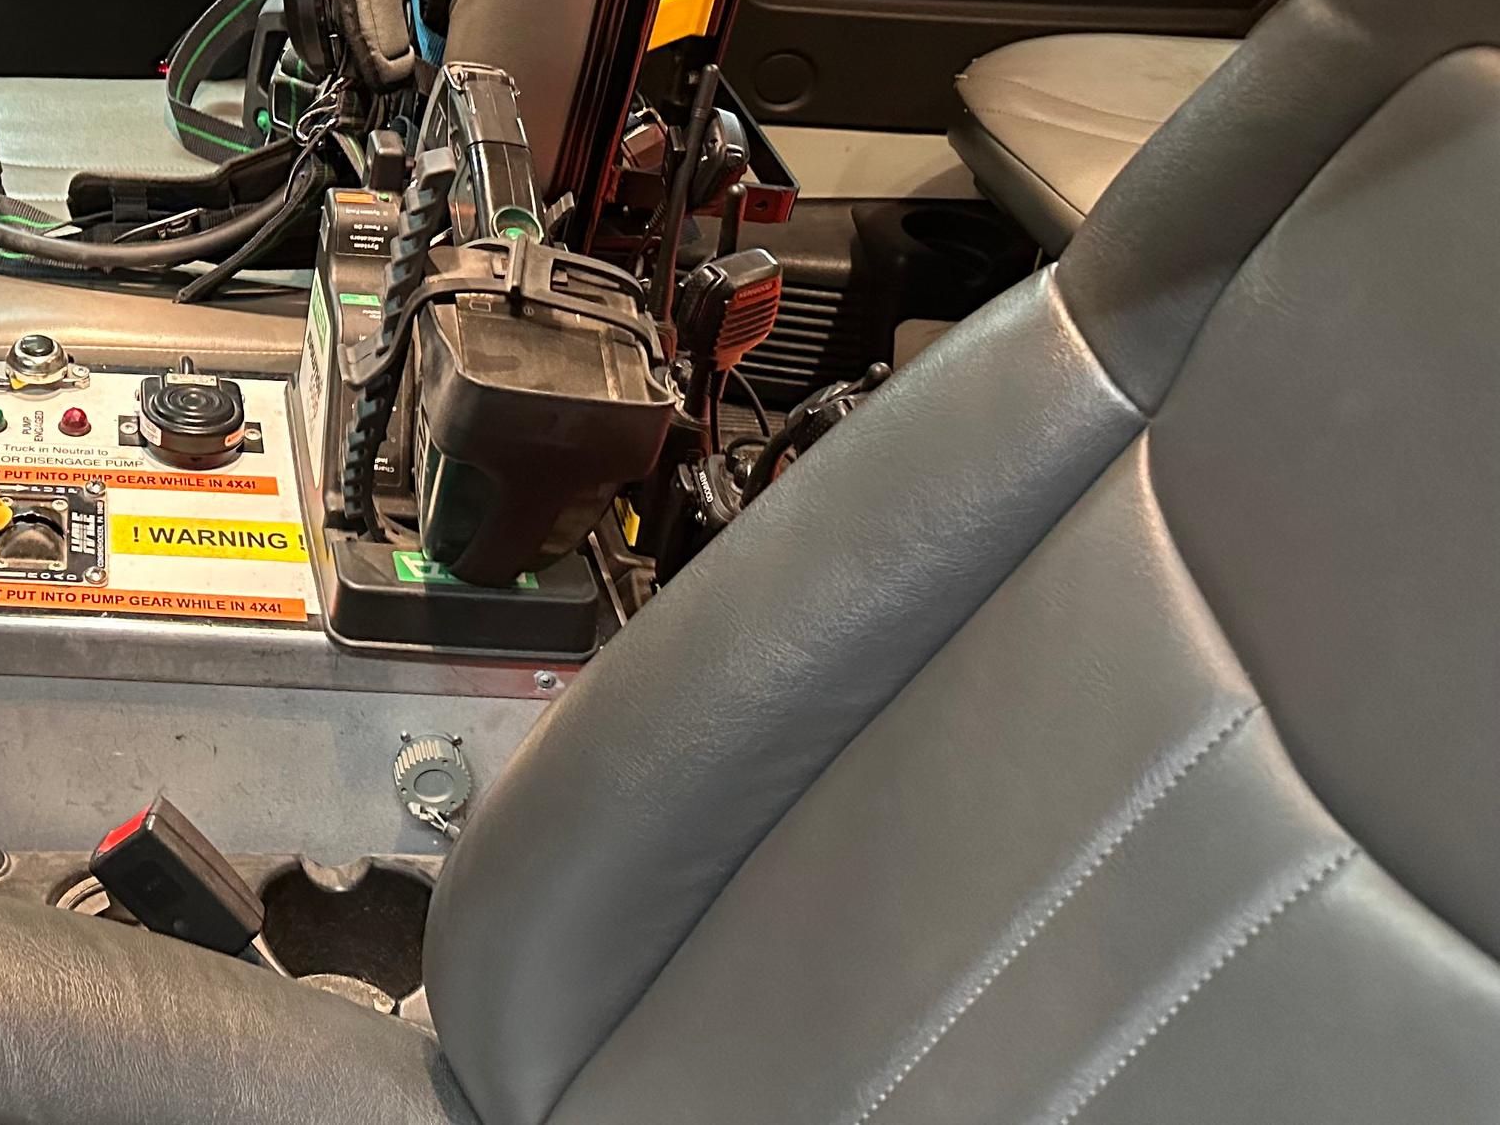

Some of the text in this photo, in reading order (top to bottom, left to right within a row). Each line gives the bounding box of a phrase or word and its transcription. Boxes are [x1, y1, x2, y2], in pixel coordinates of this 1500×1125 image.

[350, 235, 385, 244] Indicators
[354, 243, 379, 251] System
[22, 416, 32, 435] PUMP
[34, 410, 44, 442] ENGAGED
[4, 443, 35, 453] Truck
[38, 445, 49, 453] in
[52, 445, 94, 456] Neutral
[97, 447, 109, 456] to
[1, 455, 20, 464] OR
[24, 456, 102, 466] DISENGAGE
[105, 459, 144, 468] PUMP
[4, 470, 30, 480] PUT
[36, 471, 68, 482] INTO
[73, 473, 113, 483] PUMP
[116, 474, 156, 485] GEAR
[159, 476, 206, 487] WHILE
[209, 477, 223, 487] IN
[226, 478, 257, 489] 4X4!
[699, 471, 714, 504] KENWOOD
[31, 485, 78, 494] PUMP
[132, 526, 139, 543] !
[149, 527, 288, 550] WARNING
[27, 572, 77, 581] ROAD
[6, 589, 35, 601] PUT
[40, 590, 77, 603] INTO
[81, 592, 124, 605] PUMP
[128, 595, 172, 608] GEAR
[176, 597, 226, 611] WHILE
[230, 600, 245, 611] IN
[249, 601, 282, 614] 4X4!
